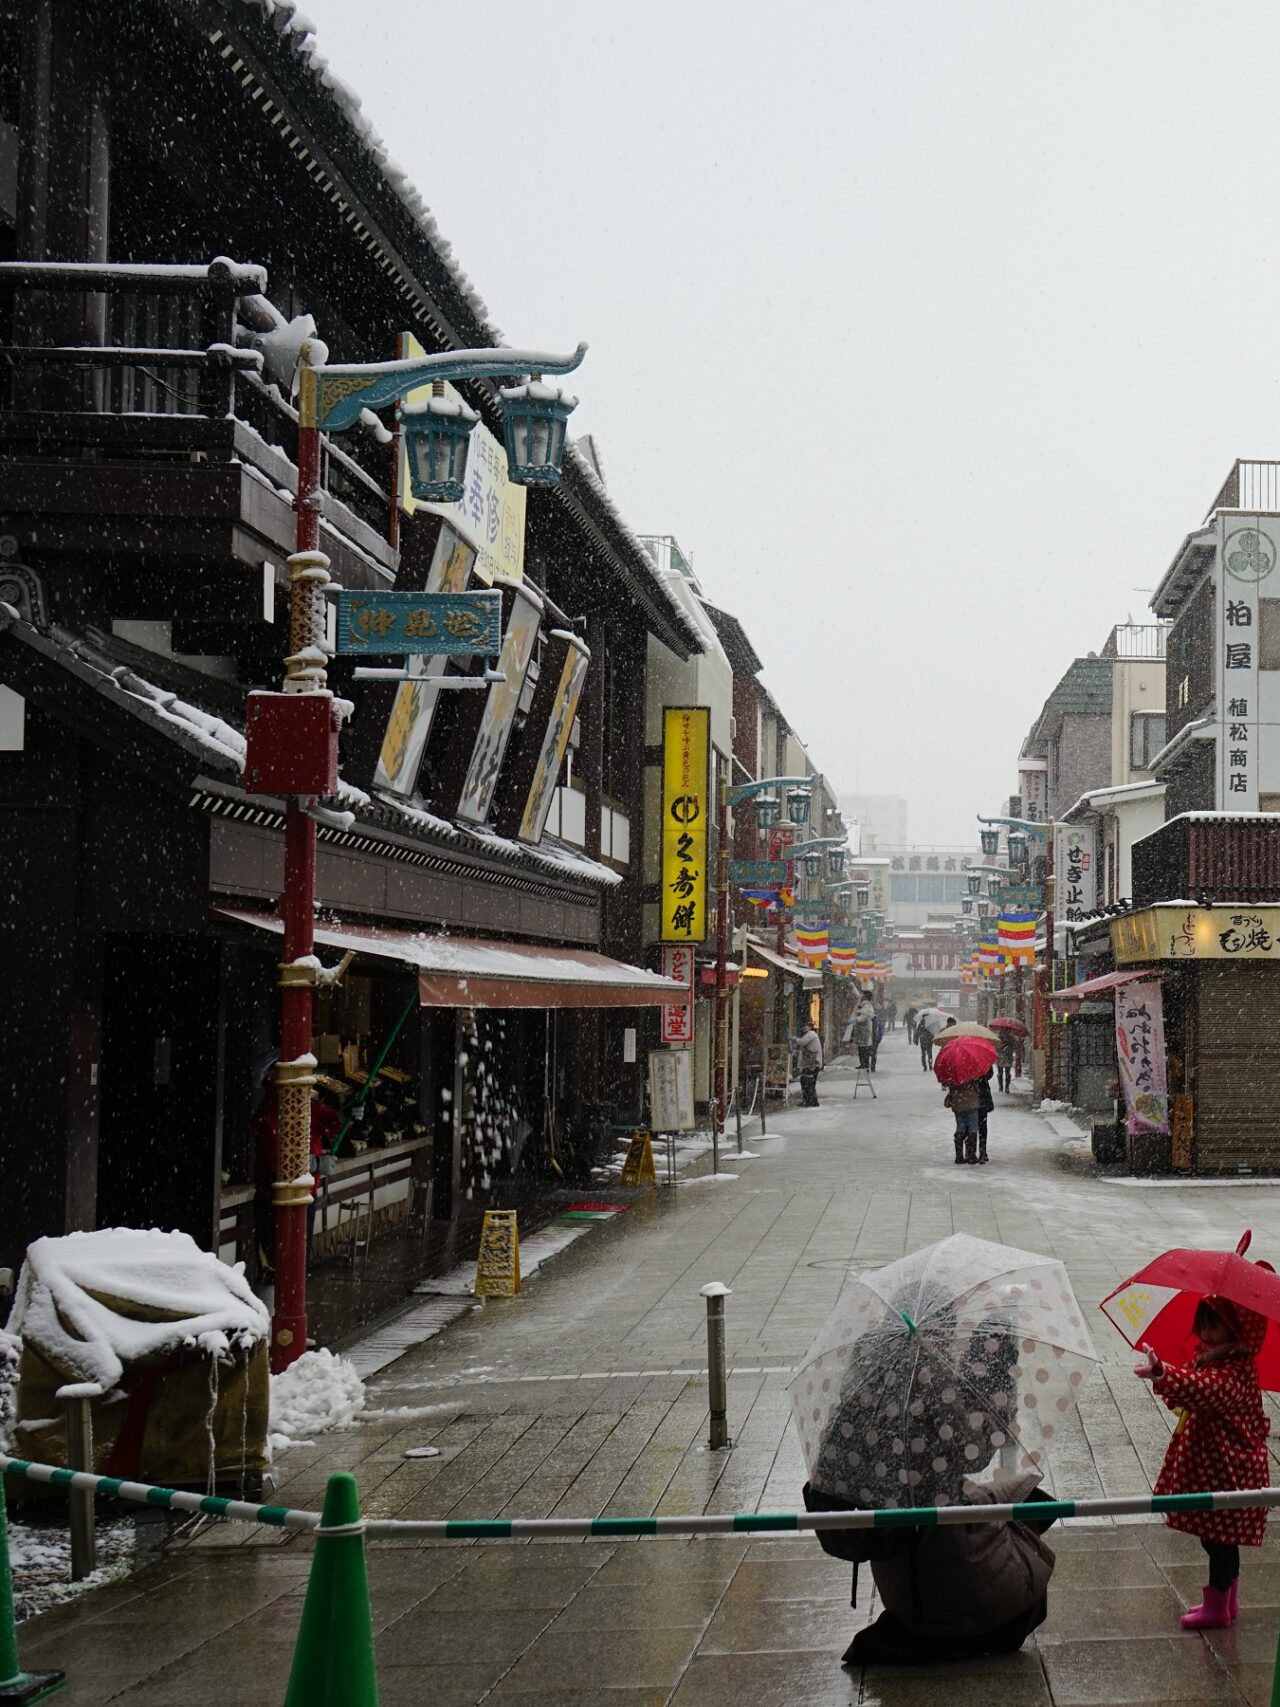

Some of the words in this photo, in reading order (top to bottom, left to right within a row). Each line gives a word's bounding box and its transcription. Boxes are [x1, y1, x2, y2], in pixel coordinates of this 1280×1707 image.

[357, 607, 483, 638] 仲見世
[1225, 600, 1253, 670] 柏屋
[1228, 697, 1249, 793] 植松商店
[668, 831, 699, 938] 久寿餅
